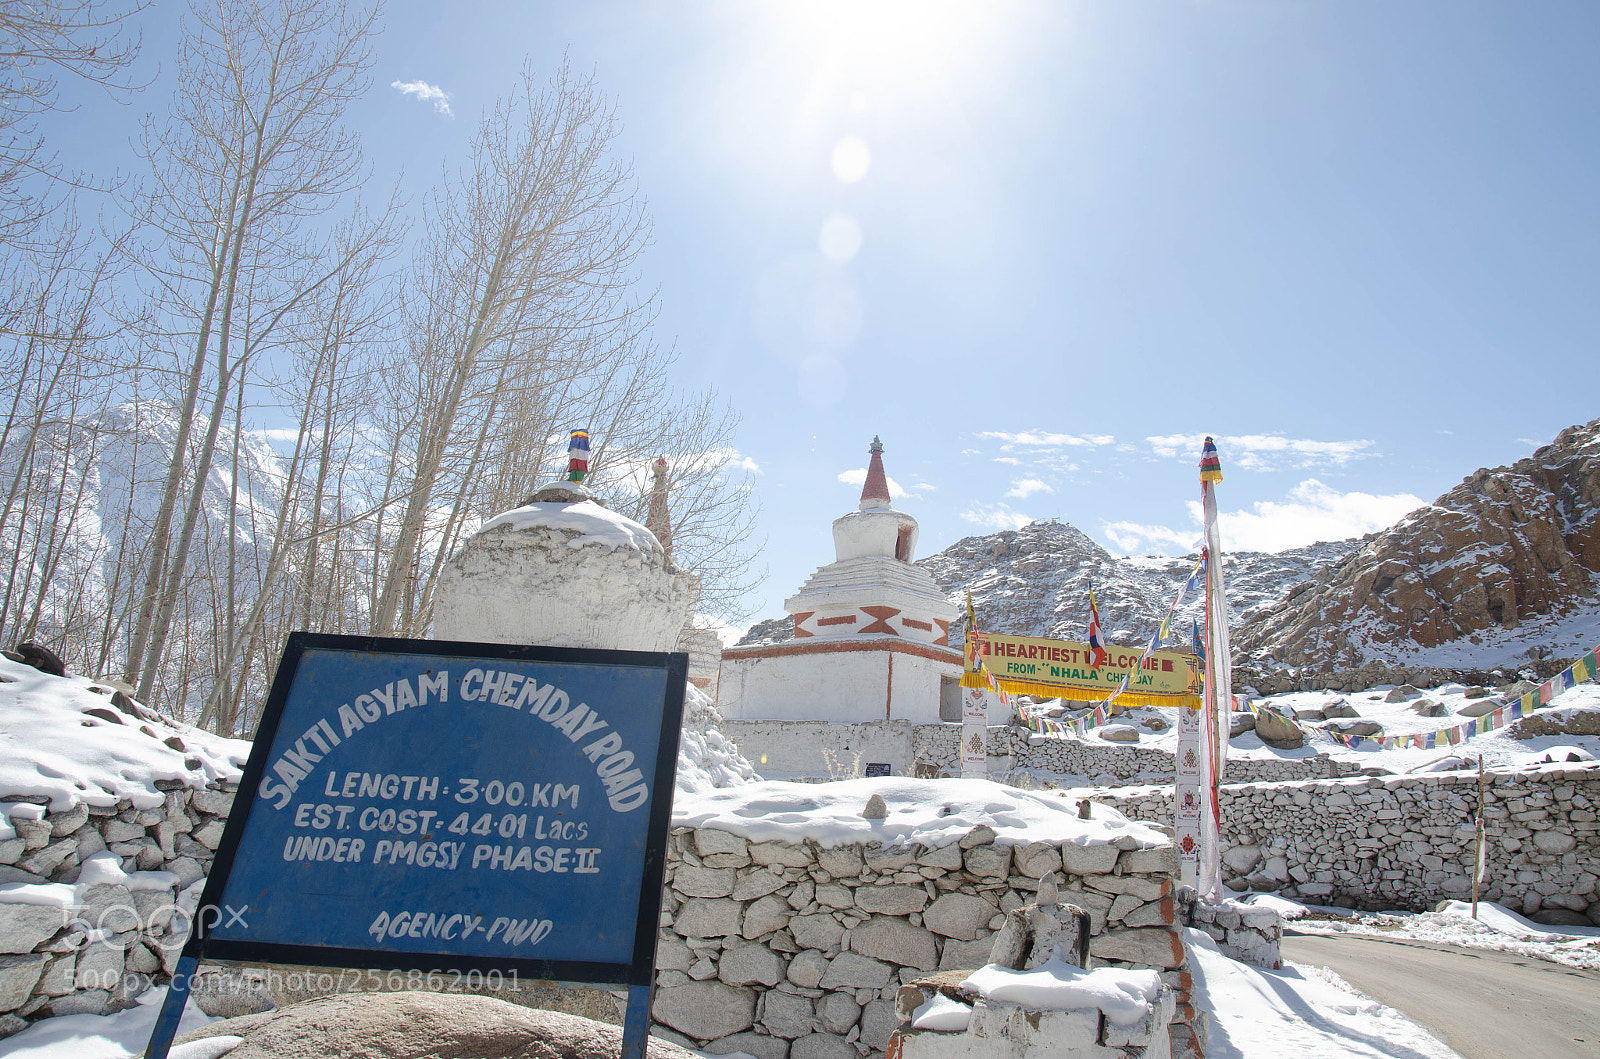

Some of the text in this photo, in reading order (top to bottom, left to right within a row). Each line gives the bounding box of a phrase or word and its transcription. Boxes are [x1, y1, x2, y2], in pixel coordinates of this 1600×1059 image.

[994, 641, 1080, 664] HEARTIEST
[1106, 671, 1154, 686] CHEDAY
[258, 668, 649, 813] SAKTI AGYAM CHEMDAY ROAD
[294, 803, 356, 830] EST.
[535, 815, 588, 841] Lacs
[283, 836, 366, 863] UNDER
[373, 840, 466, 870] PMGSY
